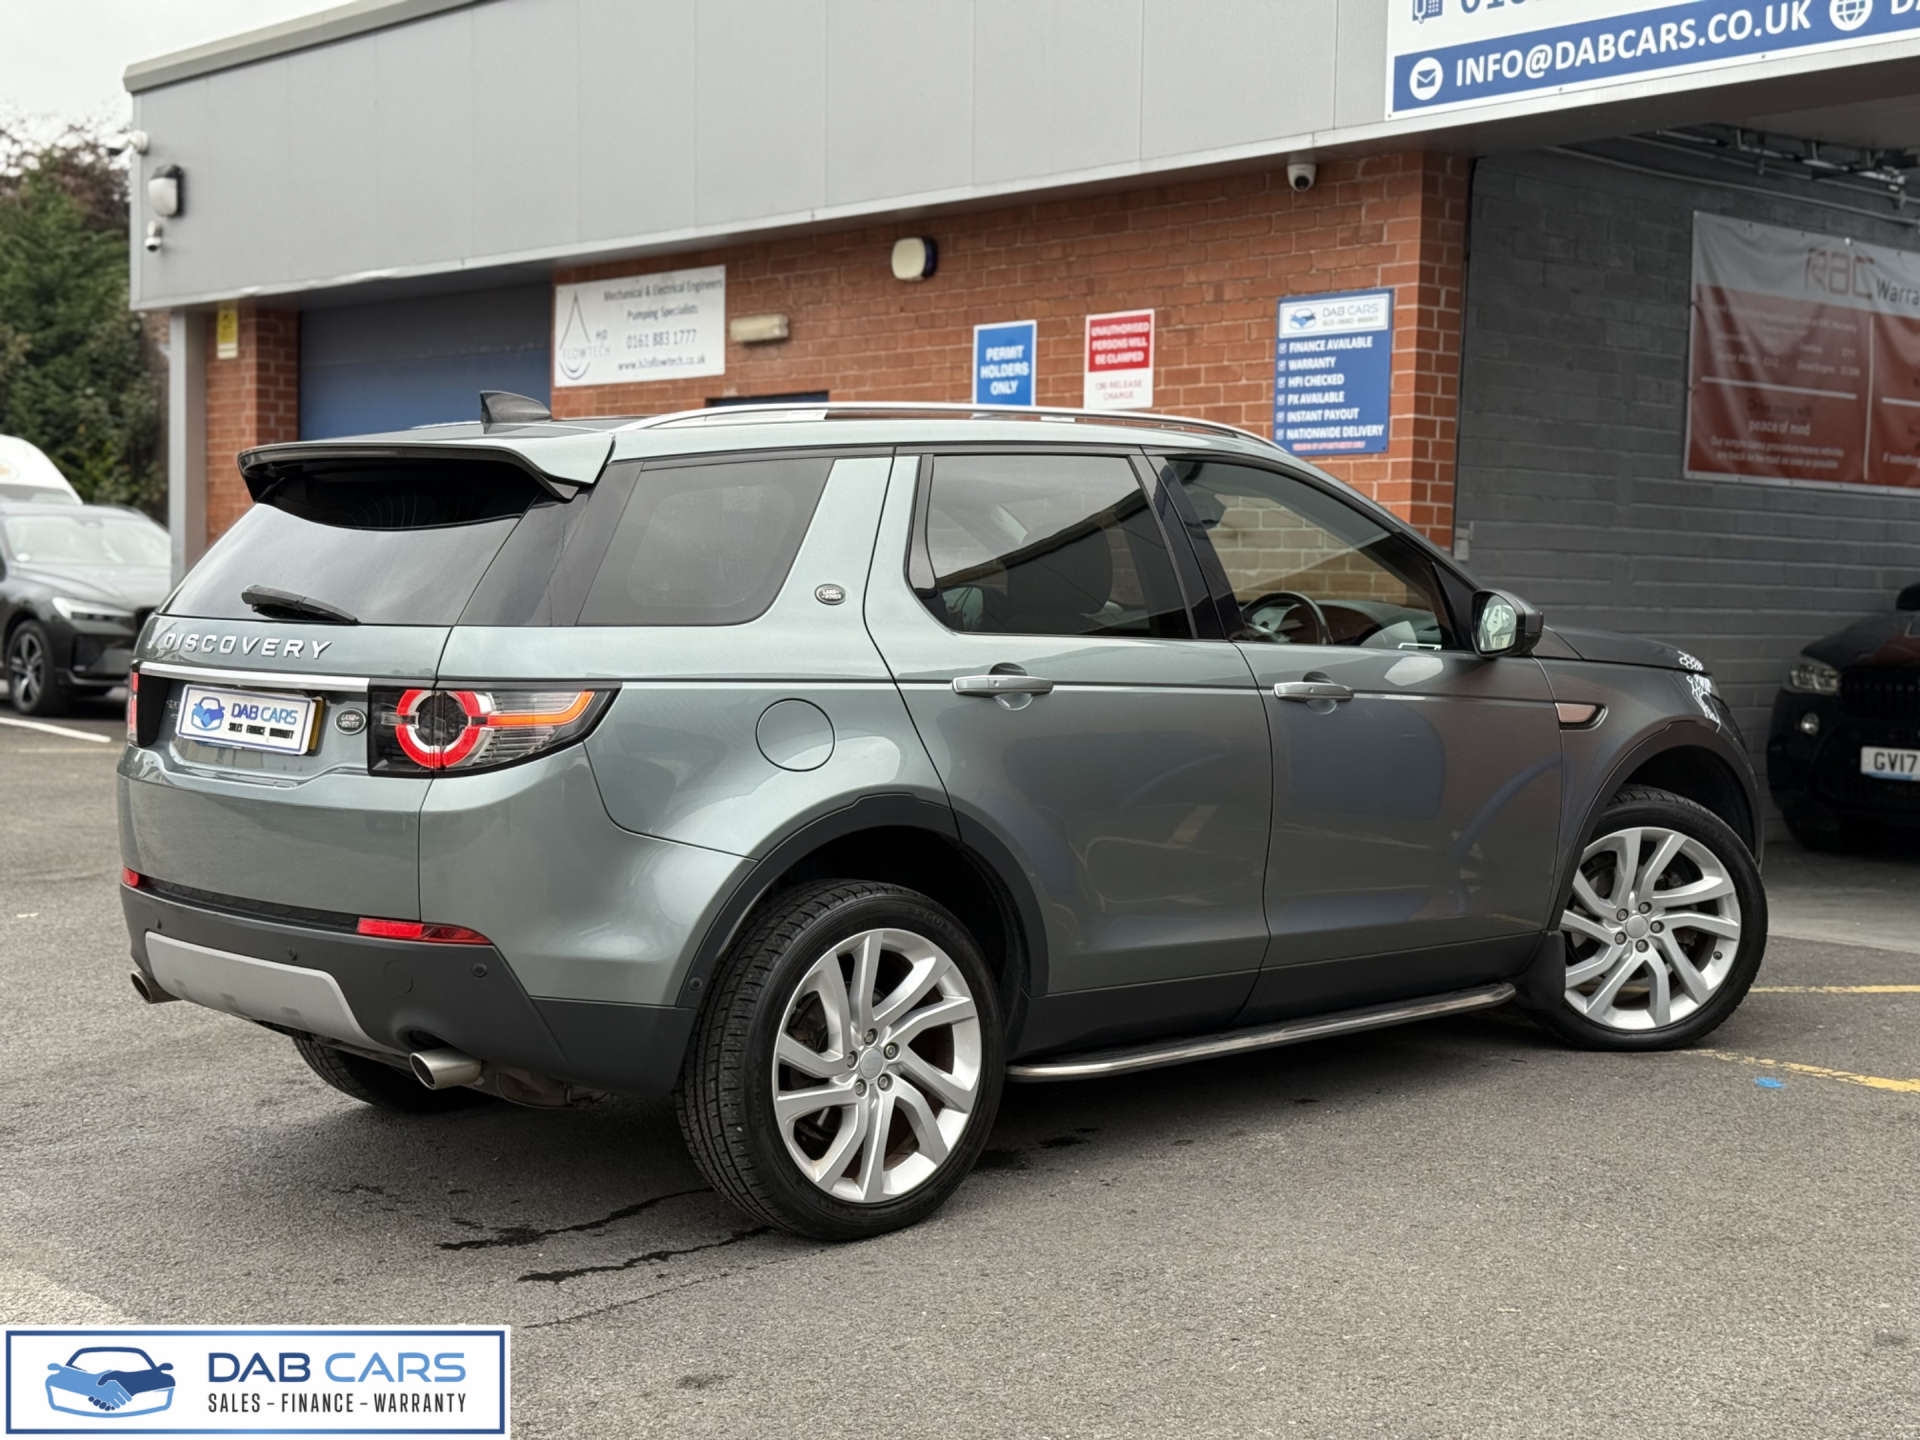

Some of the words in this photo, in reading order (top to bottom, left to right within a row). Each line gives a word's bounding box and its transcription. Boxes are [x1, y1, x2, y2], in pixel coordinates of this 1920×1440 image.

[1455, 1, 1811, 87] INFO@DABCARS.CO.UK
[1322, 306, 1345, 318] DAB
[1347, 303, 1378, 315] CARS
[626, 334, 649, 350] 0161
[674, 329, 697, 345] 1777
[1288, 340, 1326, 354] FINANCE
[1327, 336, 1374, 351] AVAILABLE
[985, 344, 1025, 361] PERMIT
[980, 362, 1029, 379] HOLDERS
[1288, 356, 1337, 371] WARRANTY
[990, 380, 1019, 396] ONLY
[1288, 376, 1303, 388] HPI
[1304, 373, 1345, 387] CHECKED
[1287, 394, 1301, 405] PX
[1301, 391, 1345, 405] AVAILABLE
[1286, 410, 1322, 423] INSTANT
[1324, 408, 1360, 421] PAYOUT
[1286, 427, 1342, 440] NATIONWIDE
[1343, 424, 1384, 438] DELIVERY
[163, 632, 334, 659] DISCOVERY
[231, 702, 259, 720] DAB
[260, 705, 298, 726] CARS
[1873, 751, 1918, 773] GV17
